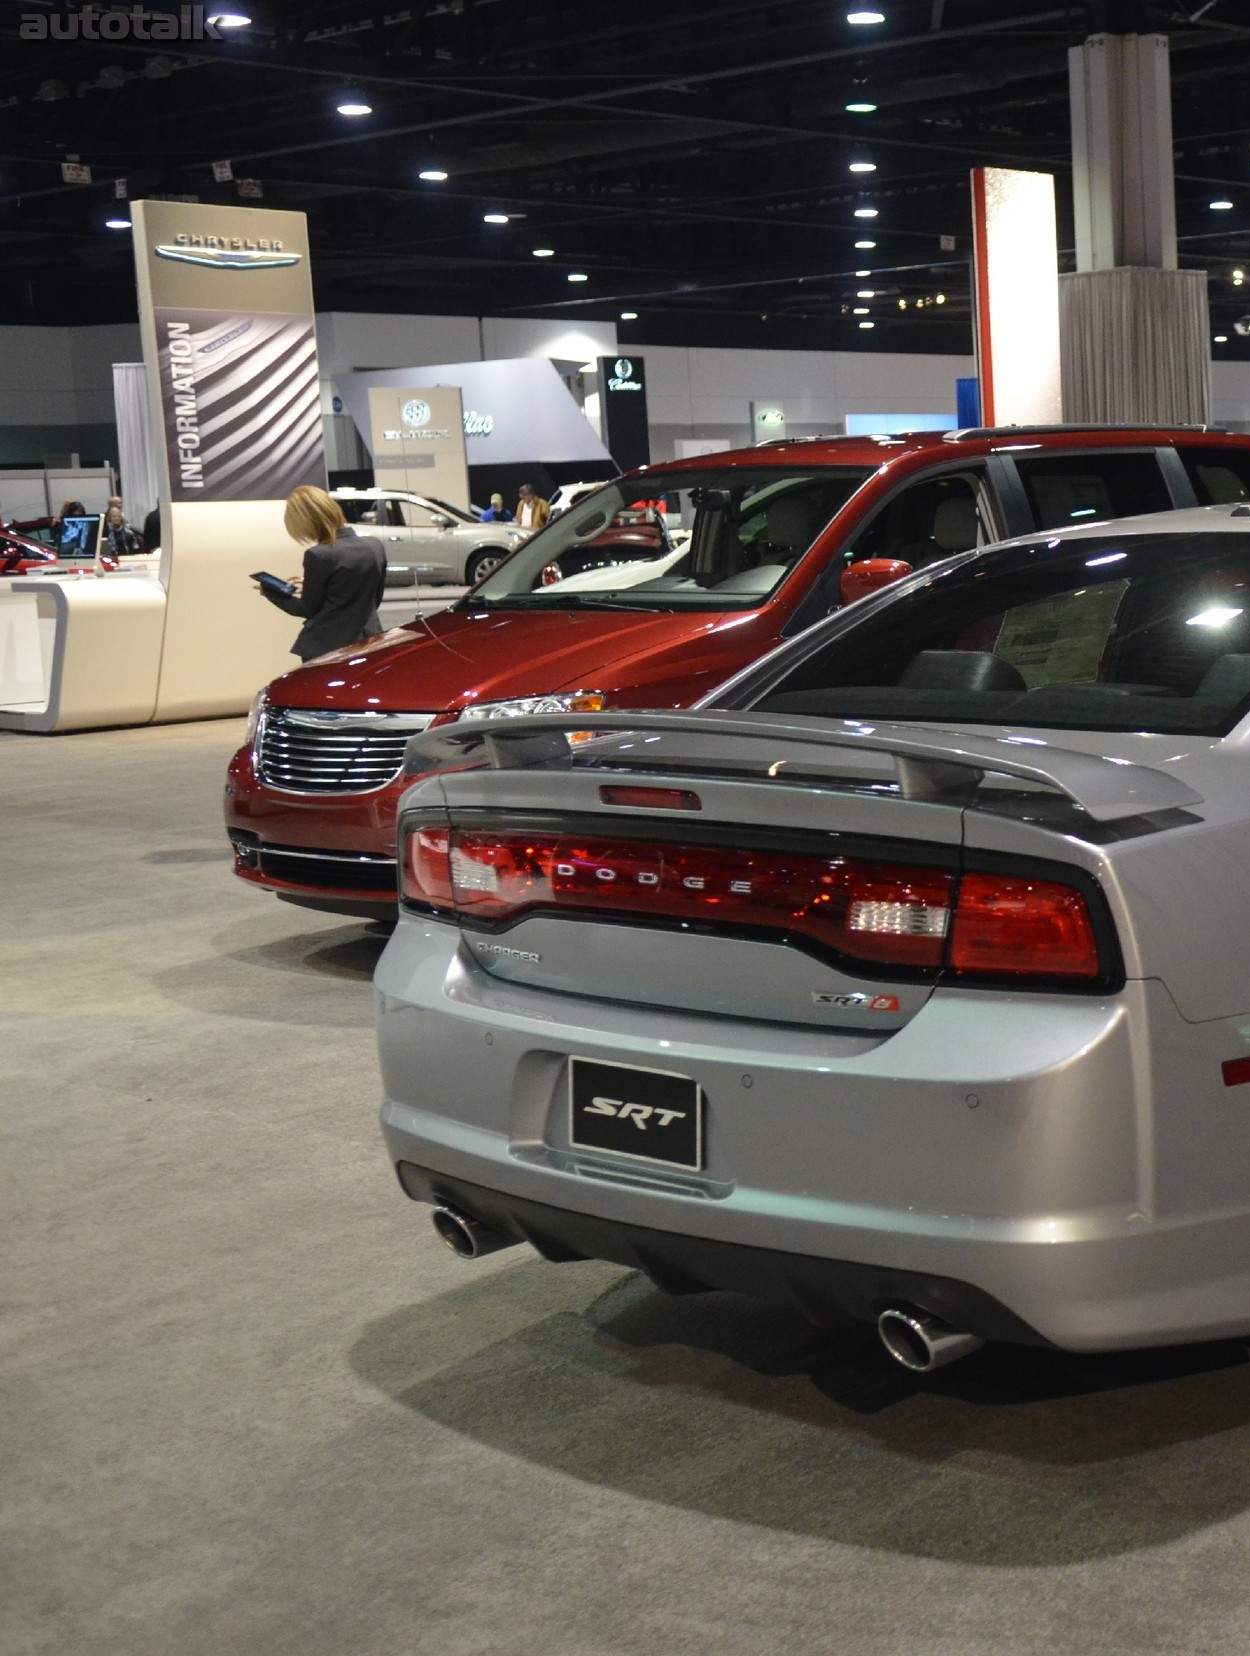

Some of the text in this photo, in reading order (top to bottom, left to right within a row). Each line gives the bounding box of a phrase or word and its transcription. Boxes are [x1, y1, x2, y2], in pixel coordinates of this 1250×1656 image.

[174, 233, 284, 252] CHRYSLER
[167, 322, 204, 488] INFORMATION
[557, 863, 751, 893] DODGE
[476, 942, 540, 963] CHARGER
[583, 1096, 687, 1130] SRT
